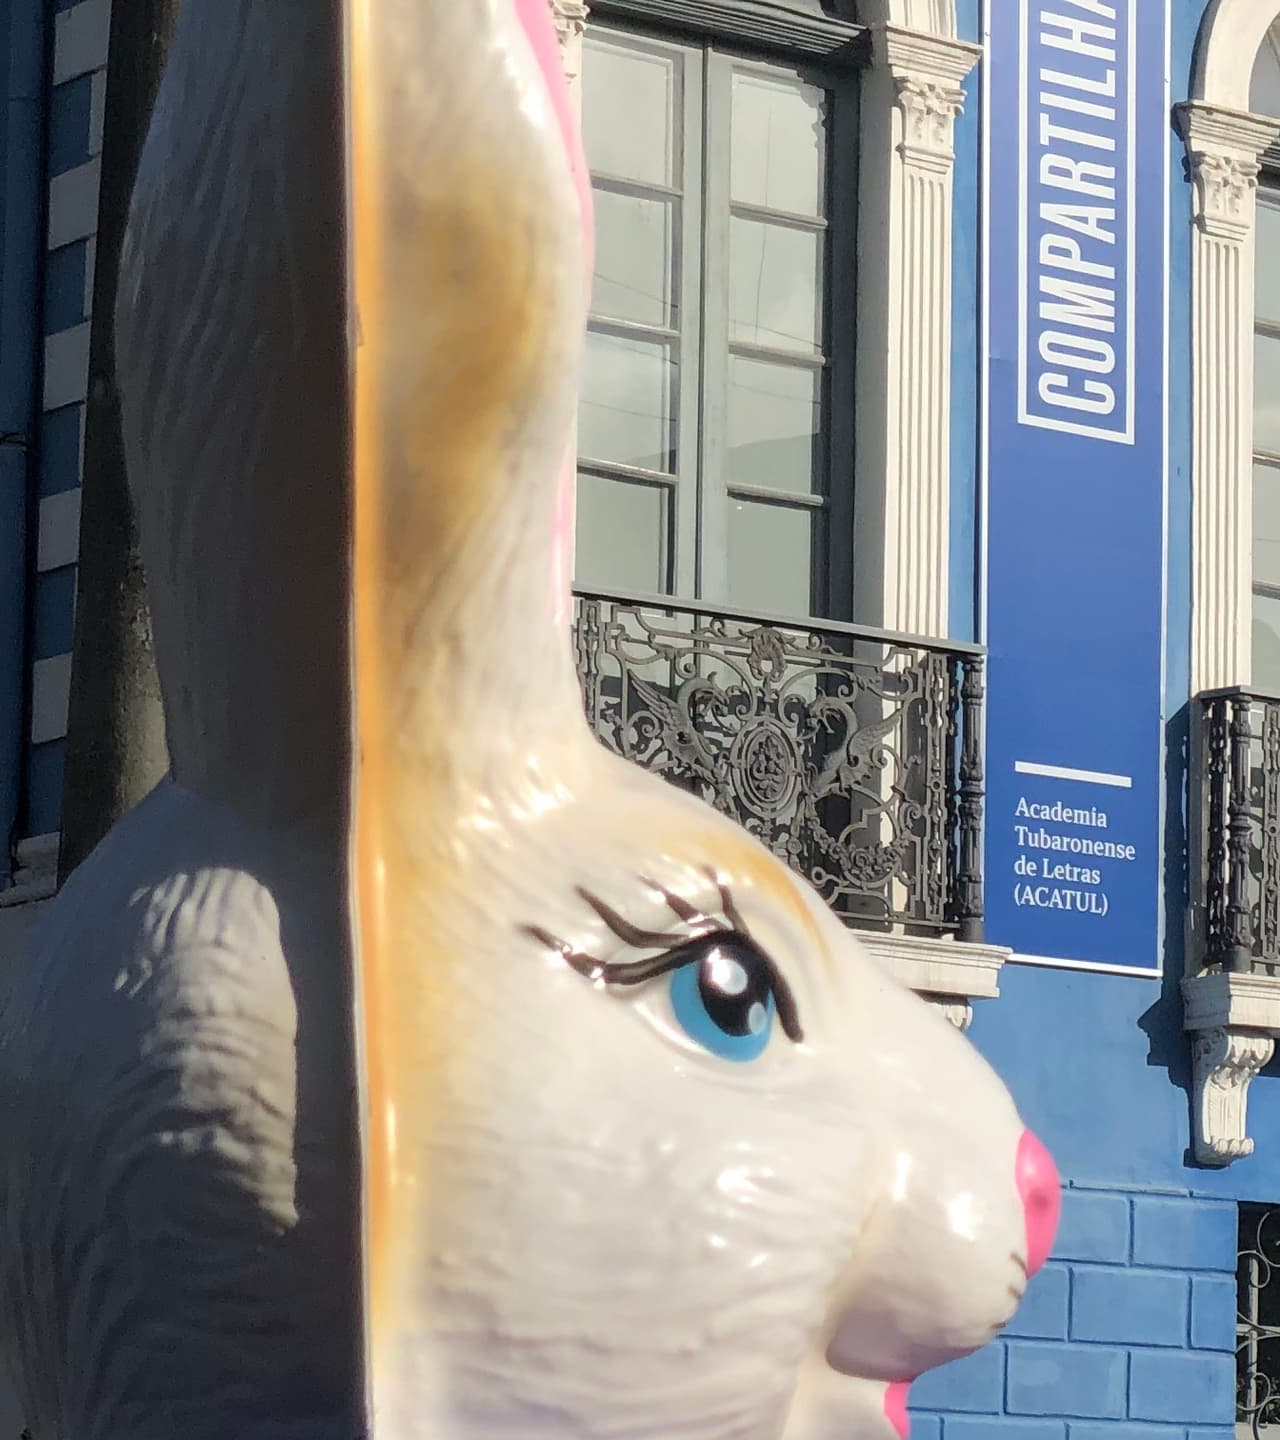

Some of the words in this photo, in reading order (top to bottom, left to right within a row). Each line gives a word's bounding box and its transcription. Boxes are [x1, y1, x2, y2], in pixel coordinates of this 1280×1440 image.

[1015, 797, 1107, 828] Academia
[1014, 825, 1136, 860] Tubaronense
[1014, 855, 1037, 877] de
[1042, 858, 1100, 885] Letras
[1014, 883, 1109, 916] (ACATUL)
